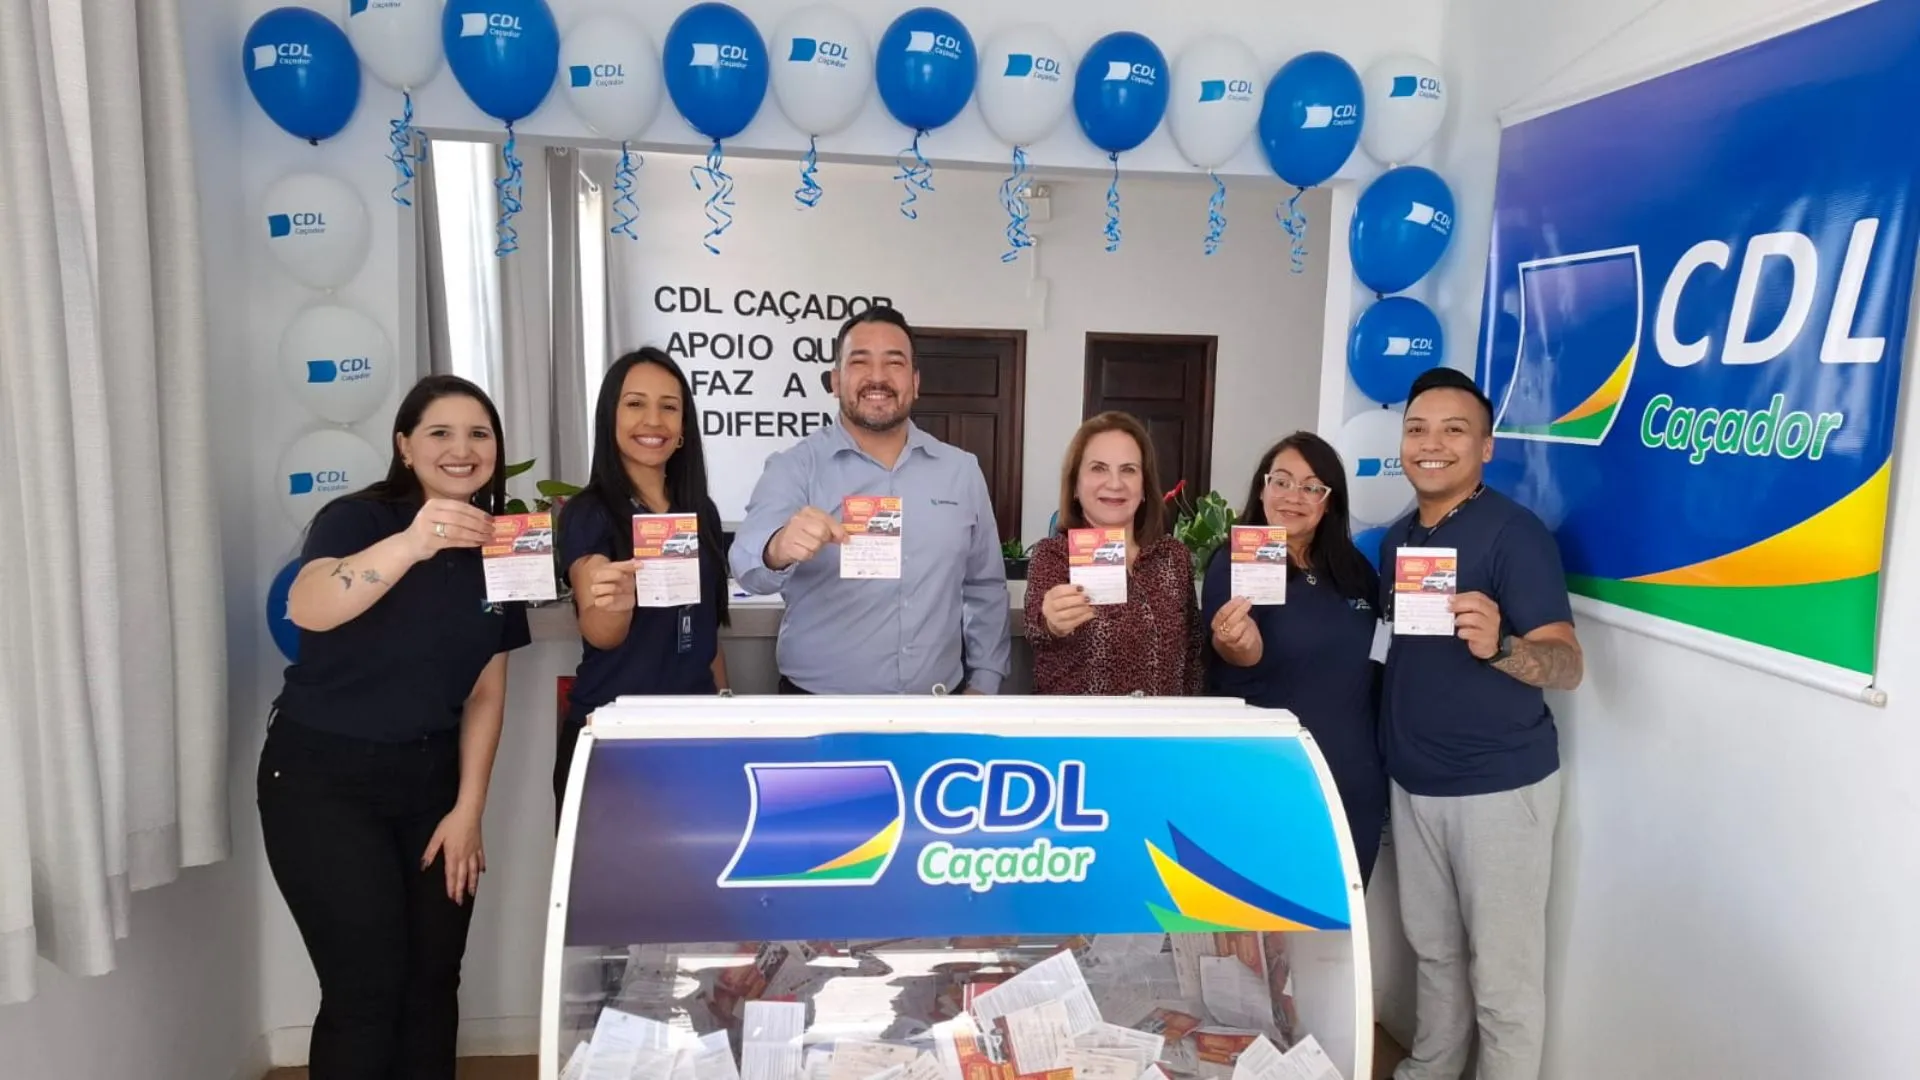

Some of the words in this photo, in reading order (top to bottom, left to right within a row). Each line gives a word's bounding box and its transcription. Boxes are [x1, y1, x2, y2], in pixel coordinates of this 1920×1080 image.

[489, 13, 522, 30] CDL
[278, 43, 312, 57] CDL
[819, 41, 848, 60] CDL
[936, 34, 962, 53] CDL
[720, 45, 749, 61] CDL
[594, 64, 625, 77] CDL
[1035, 57, 1061, 75] CDL
[1132, 63, 1156, 79] CDL
[1228, 80, 1253, 94] CDL
[1420, 77, 1441, 93] CDL
[1334, 104, 1357, 117] CDL
[293, 212, 326, 226] CDL
[654, 286, 723, 314] CDL
[1655, 218, 1886, 367] CDL
[666, 332, 773, 361] APOIO
[1411, 338, 1433, 350] CDL
[340, 357, 372, 373] CDL
[691, 370, 753, 396] FAZ
[783, 372, 807, 398] A
[1640, 393, 1843, 465] Caçador
[316, 471, 349, 483] CDL
[914, 758, 1108, 834] CDL
[918, 838, 1095, 892] Caçador
